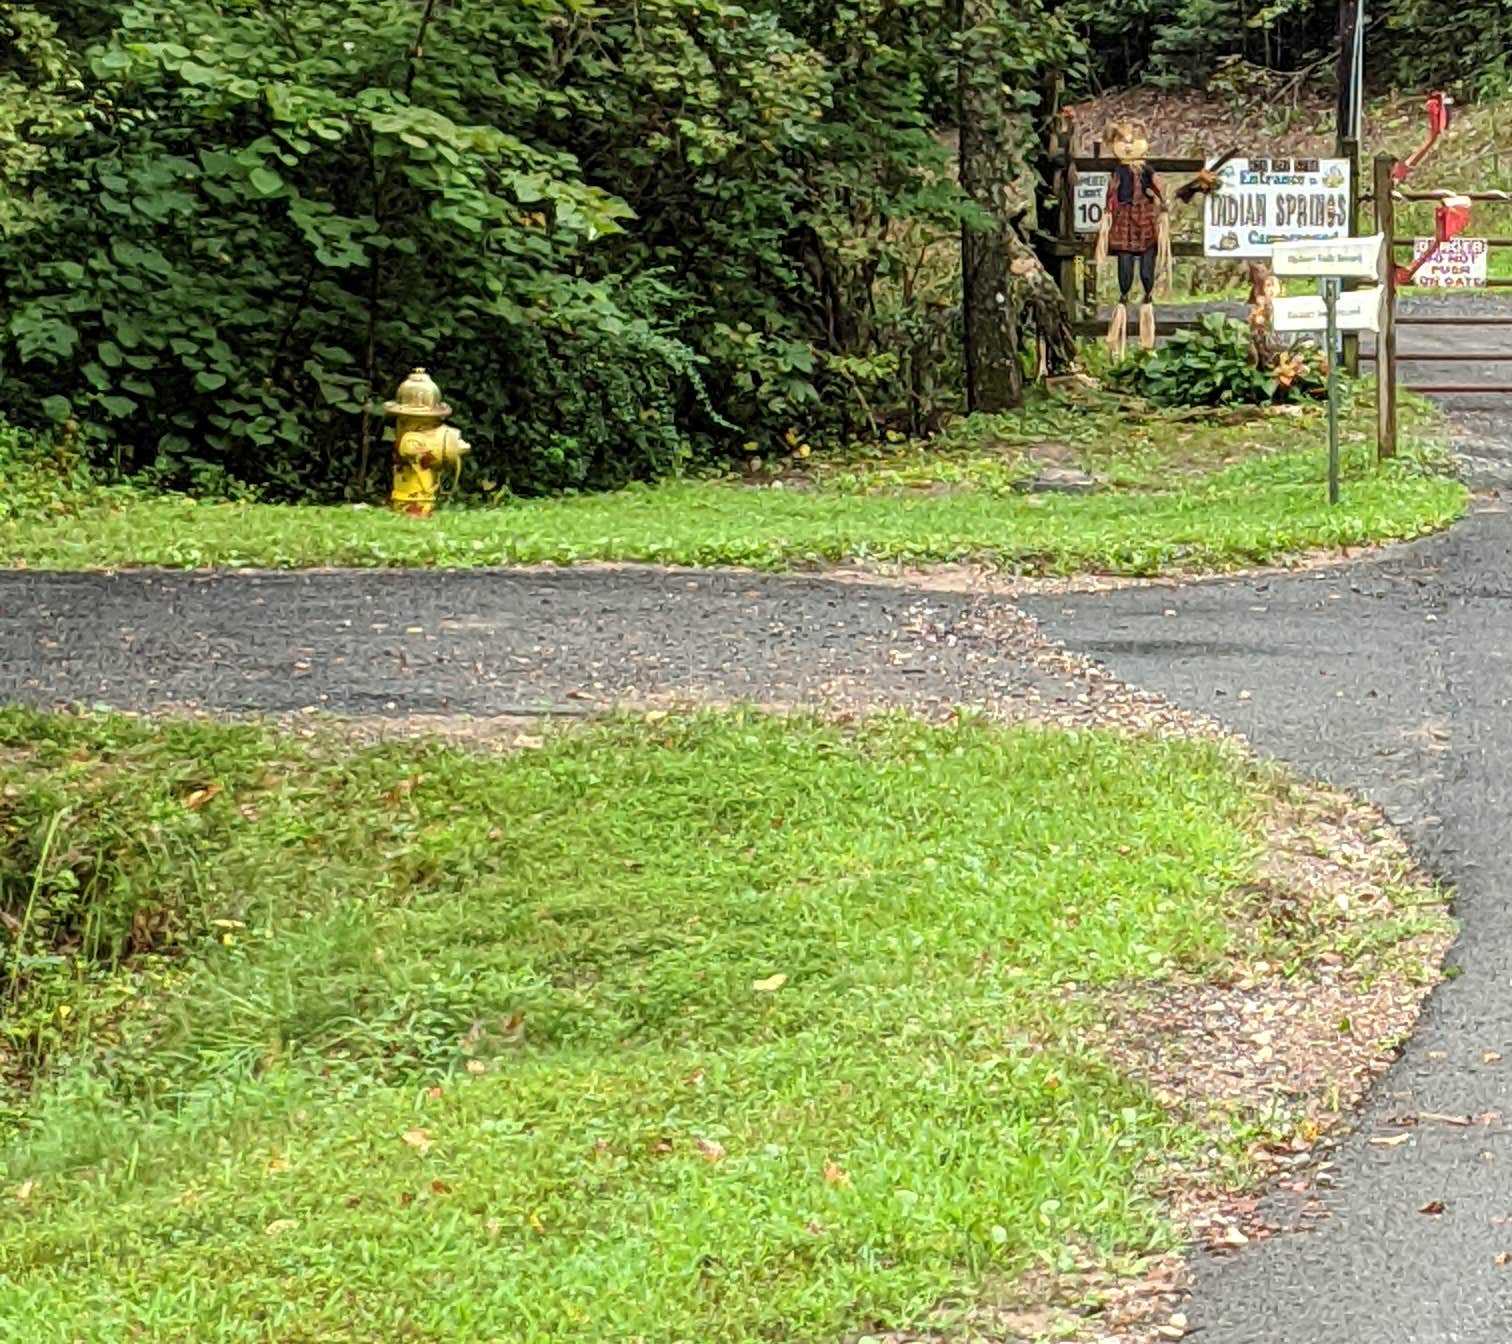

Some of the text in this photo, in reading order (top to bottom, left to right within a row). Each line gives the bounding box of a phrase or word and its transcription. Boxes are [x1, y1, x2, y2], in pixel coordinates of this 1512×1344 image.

[1078, 203, 1102, 223] 10
[1210, 192, 1346, 228] INDIAN SPRINGS
